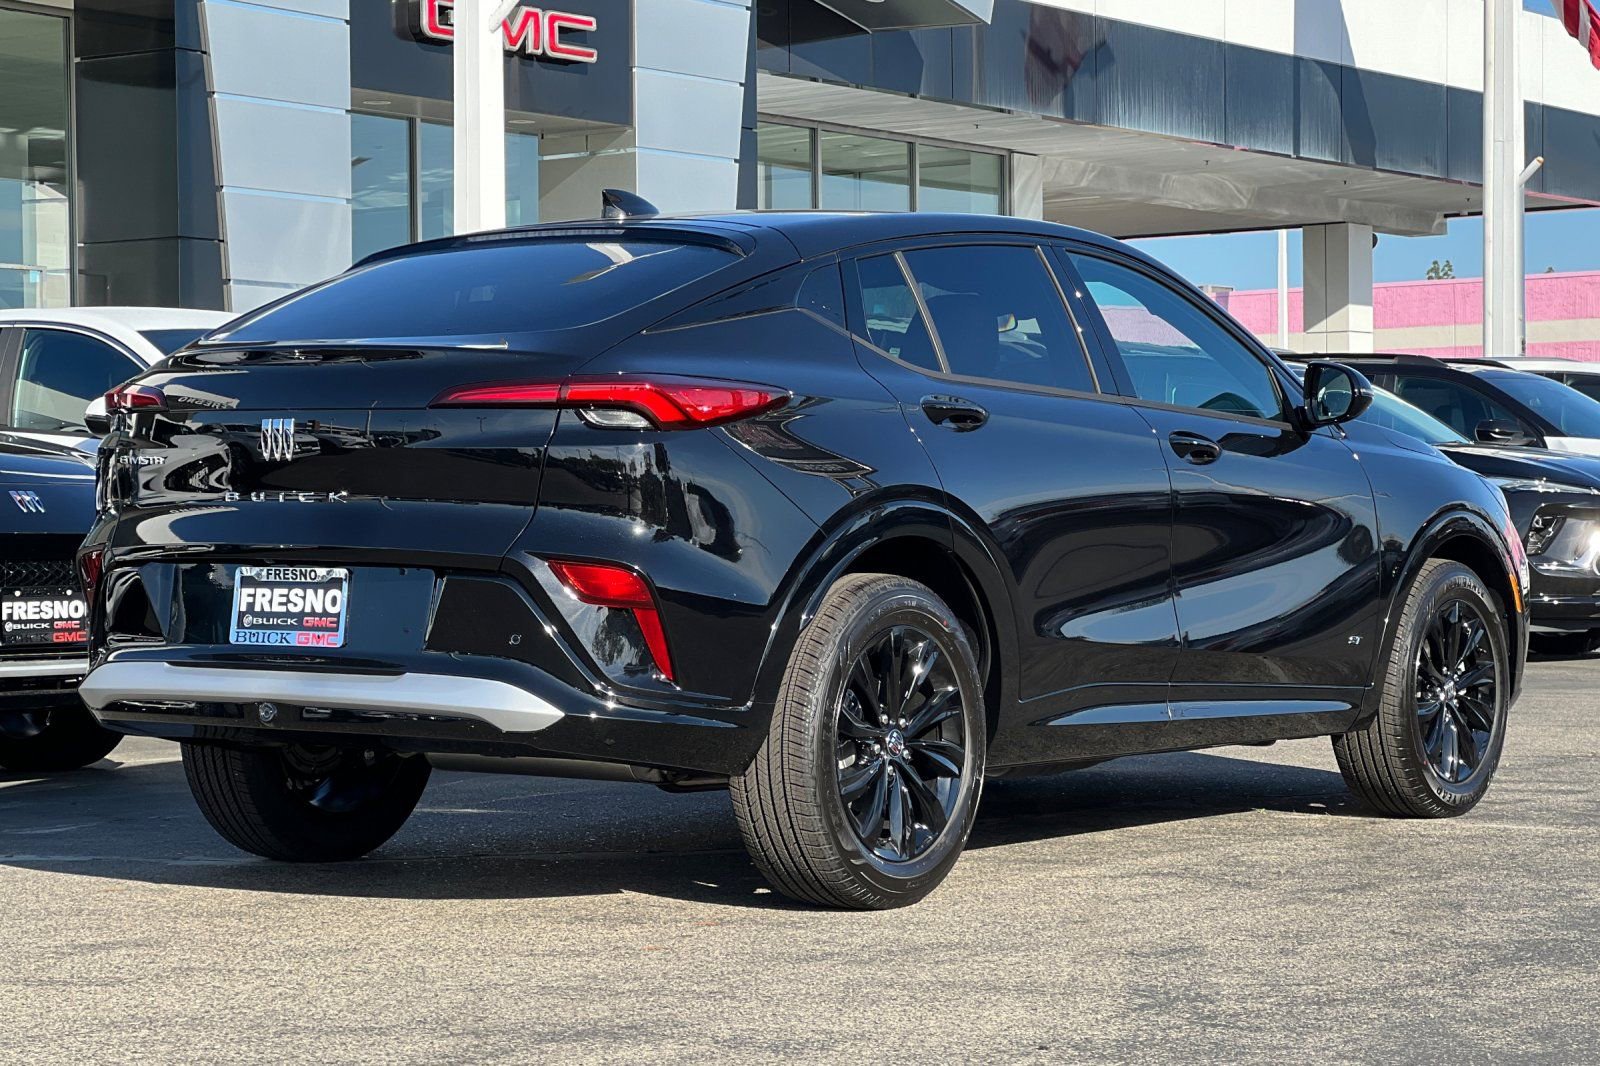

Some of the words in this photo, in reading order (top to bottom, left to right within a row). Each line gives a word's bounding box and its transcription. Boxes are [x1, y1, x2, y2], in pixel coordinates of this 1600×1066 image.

[225, 490, 348, 504] BUICK
[265, 568, 318, 581] FRESNO
[240, 587, 342, 614] FRESNO
[1, 599, 85, 621] FRESNO
[12, 622, 51, 630] BUICK
[53, 620, 81, 629] GMC
[252, 617, 299, 626] BUICK
[302, 616, 338, 628] GMC
[52, 631, 87, 643] GMC
[235, 630, 293, 645] BUICK
[296, 631, 339, 647] GMC
